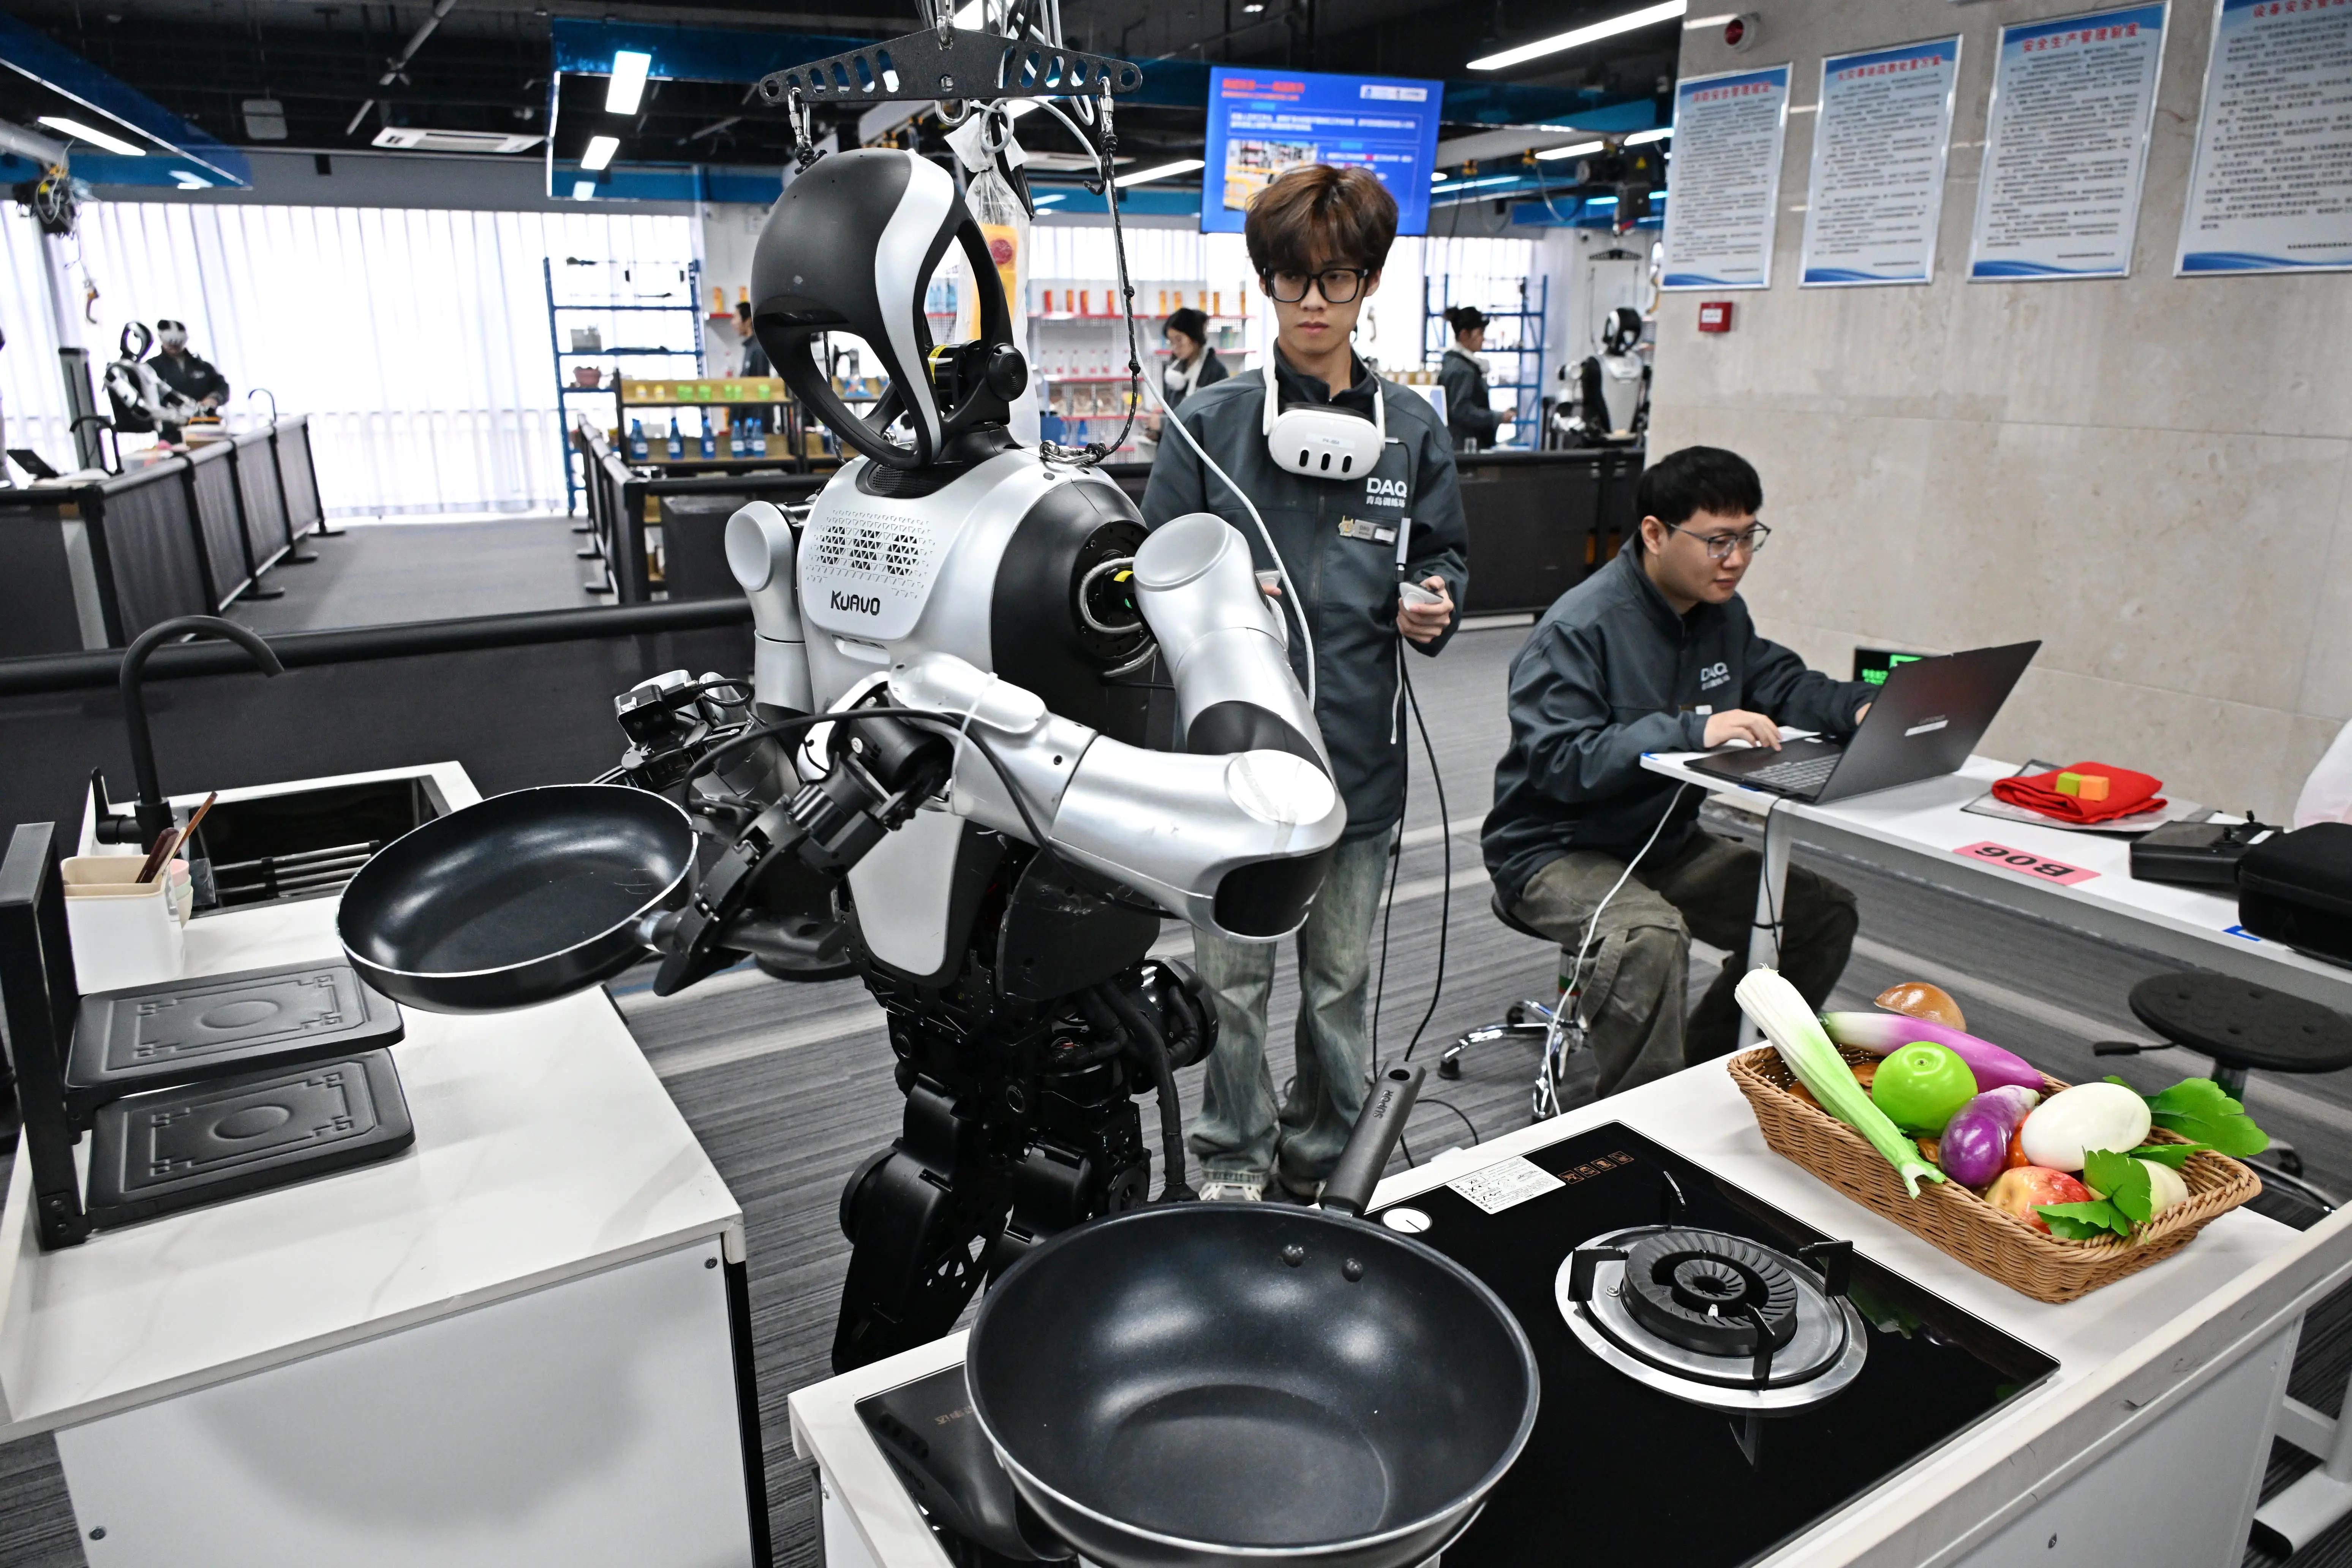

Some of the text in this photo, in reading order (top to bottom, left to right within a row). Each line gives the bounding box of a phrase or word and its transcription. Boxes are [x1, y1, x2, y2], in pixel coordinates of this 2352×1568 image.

[2023, 22, 2140, 53] 安全生产管理制度
[1366, 477, 1407, 498] DAQ
[831, 590, 880, 616] KUAVO
[1974, 847, 2075, 877] B06
[1373, 1090, 1394, 1119] SUPOR
